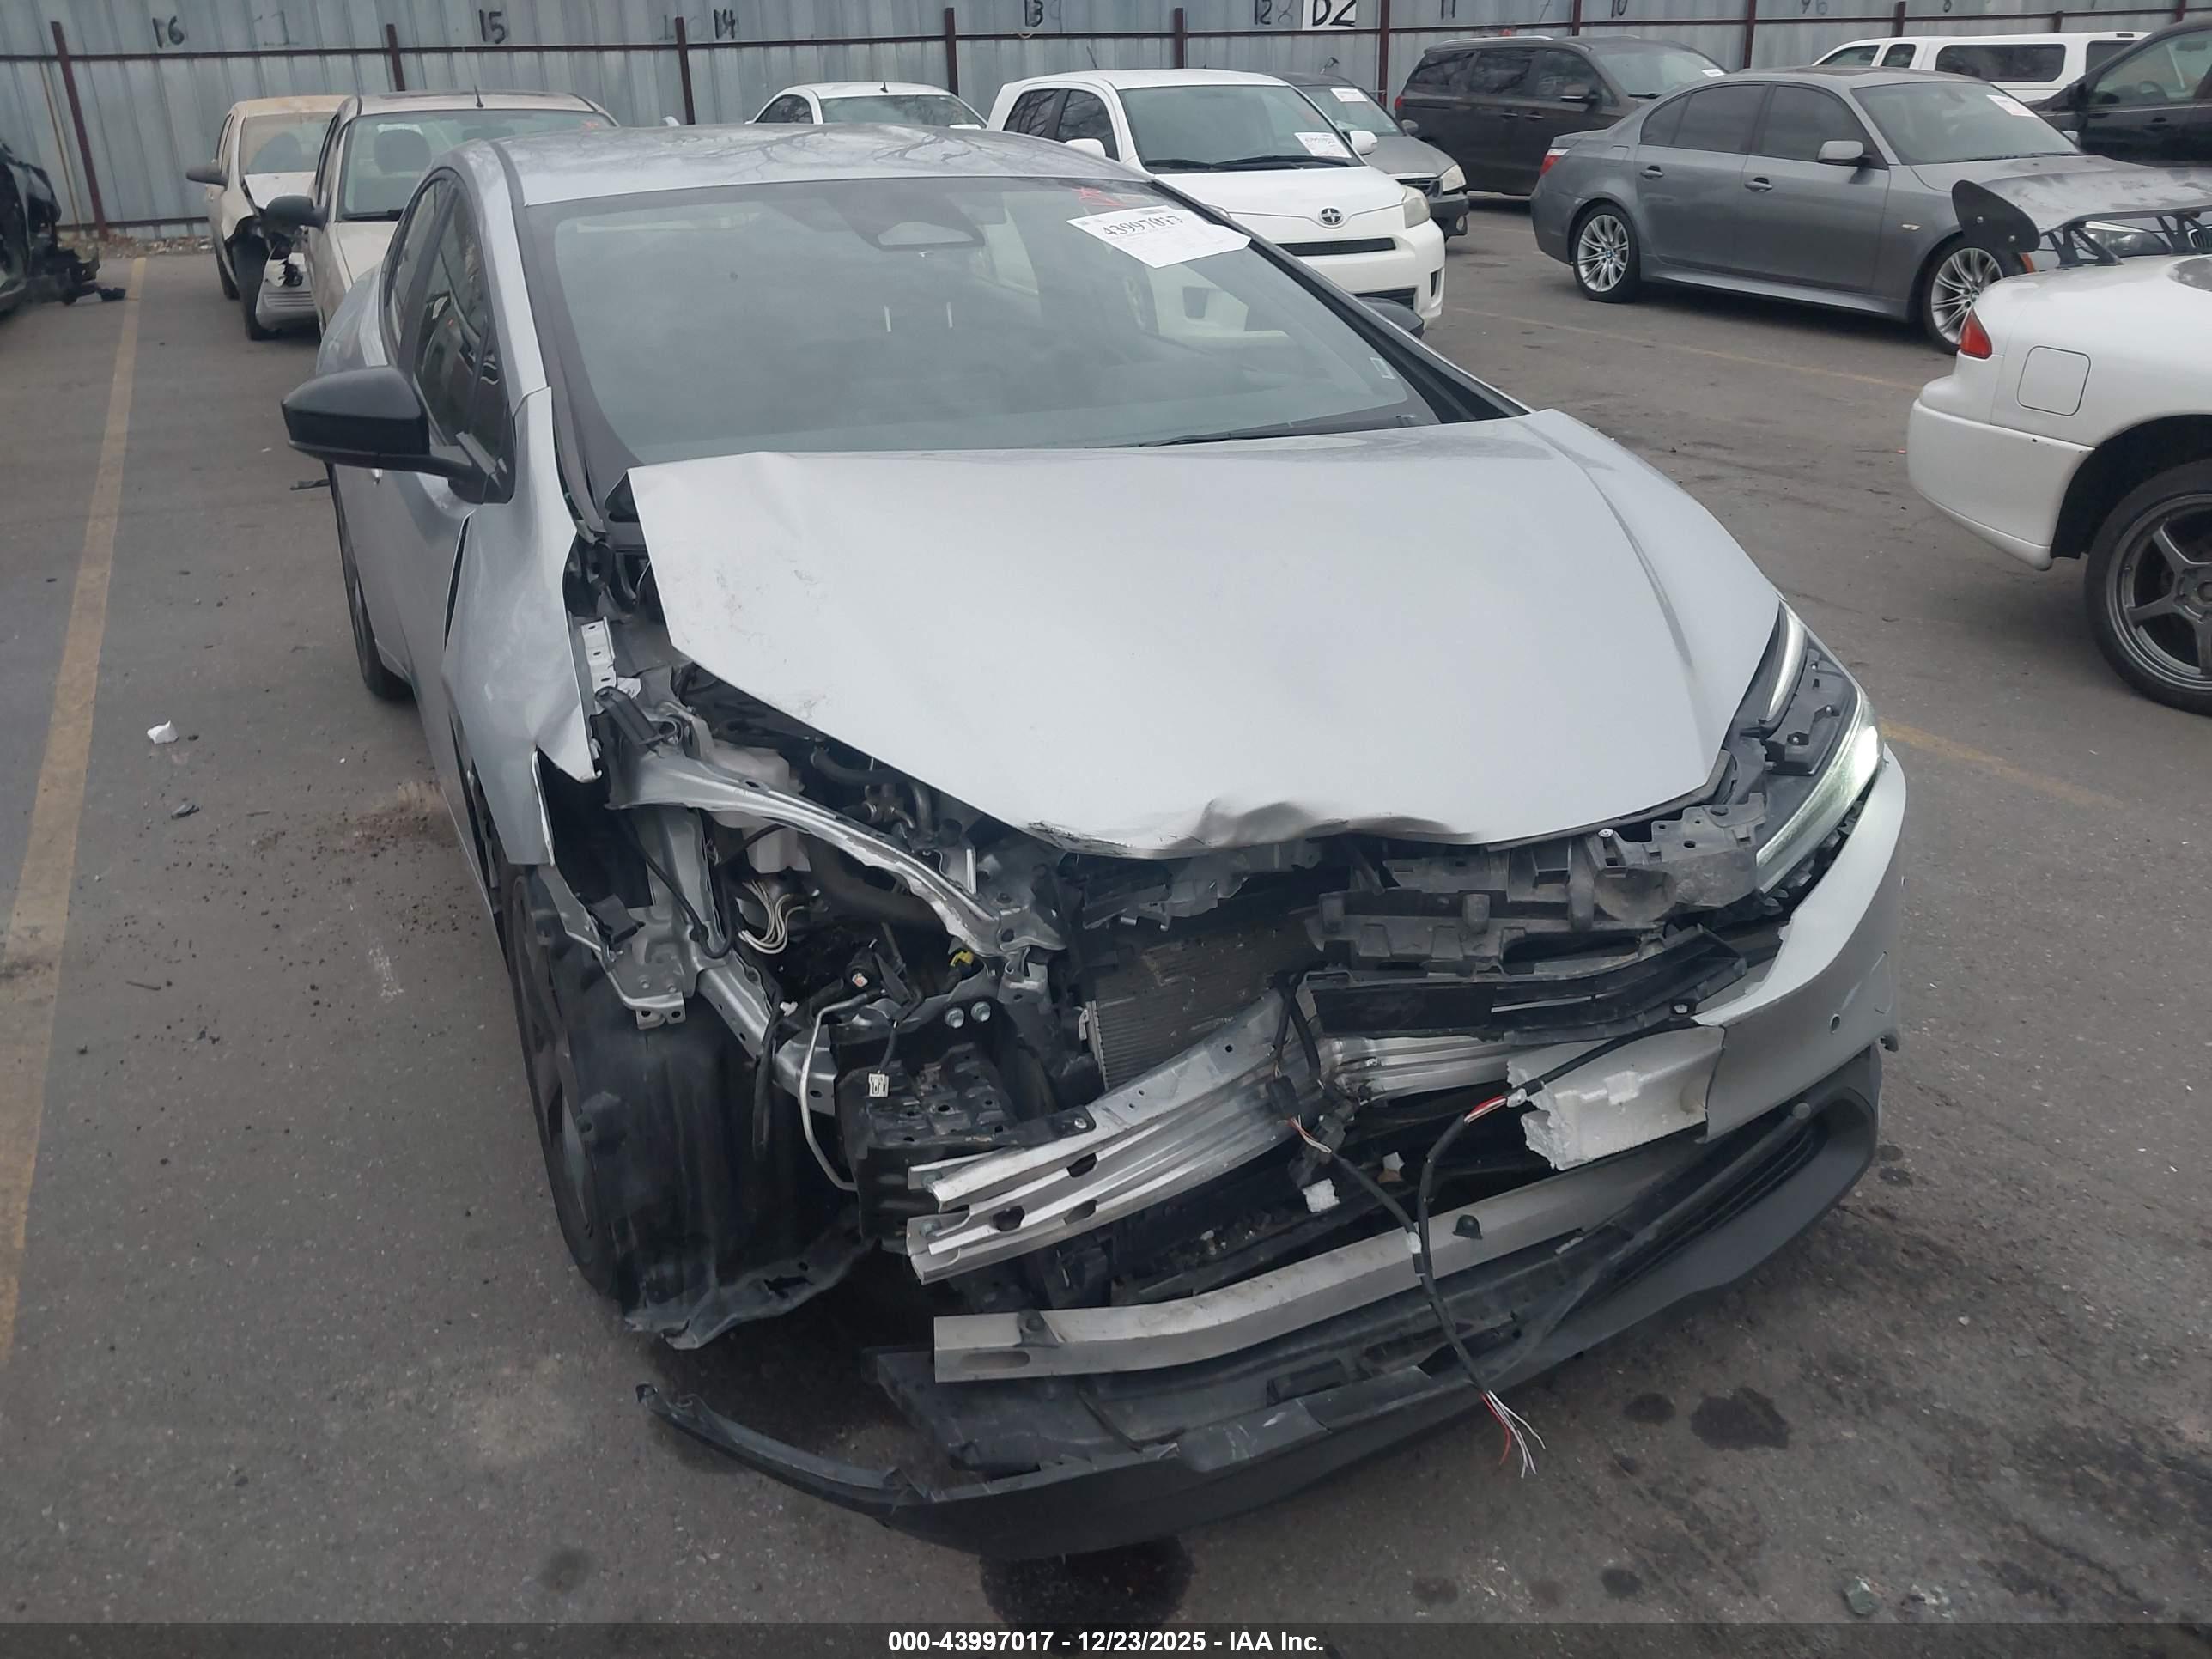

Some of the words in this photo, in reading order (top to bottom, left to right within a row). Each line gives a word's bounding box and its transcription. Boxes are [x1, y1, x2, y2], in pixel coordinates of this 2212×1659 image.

[479, 9, 506, 44] 15
[714, 9, 736, 40] 14
[1024, 0, 1043, 27] 13
[1255, 0, 1273, 25] 12
[152, 16, 185, 48] 16
